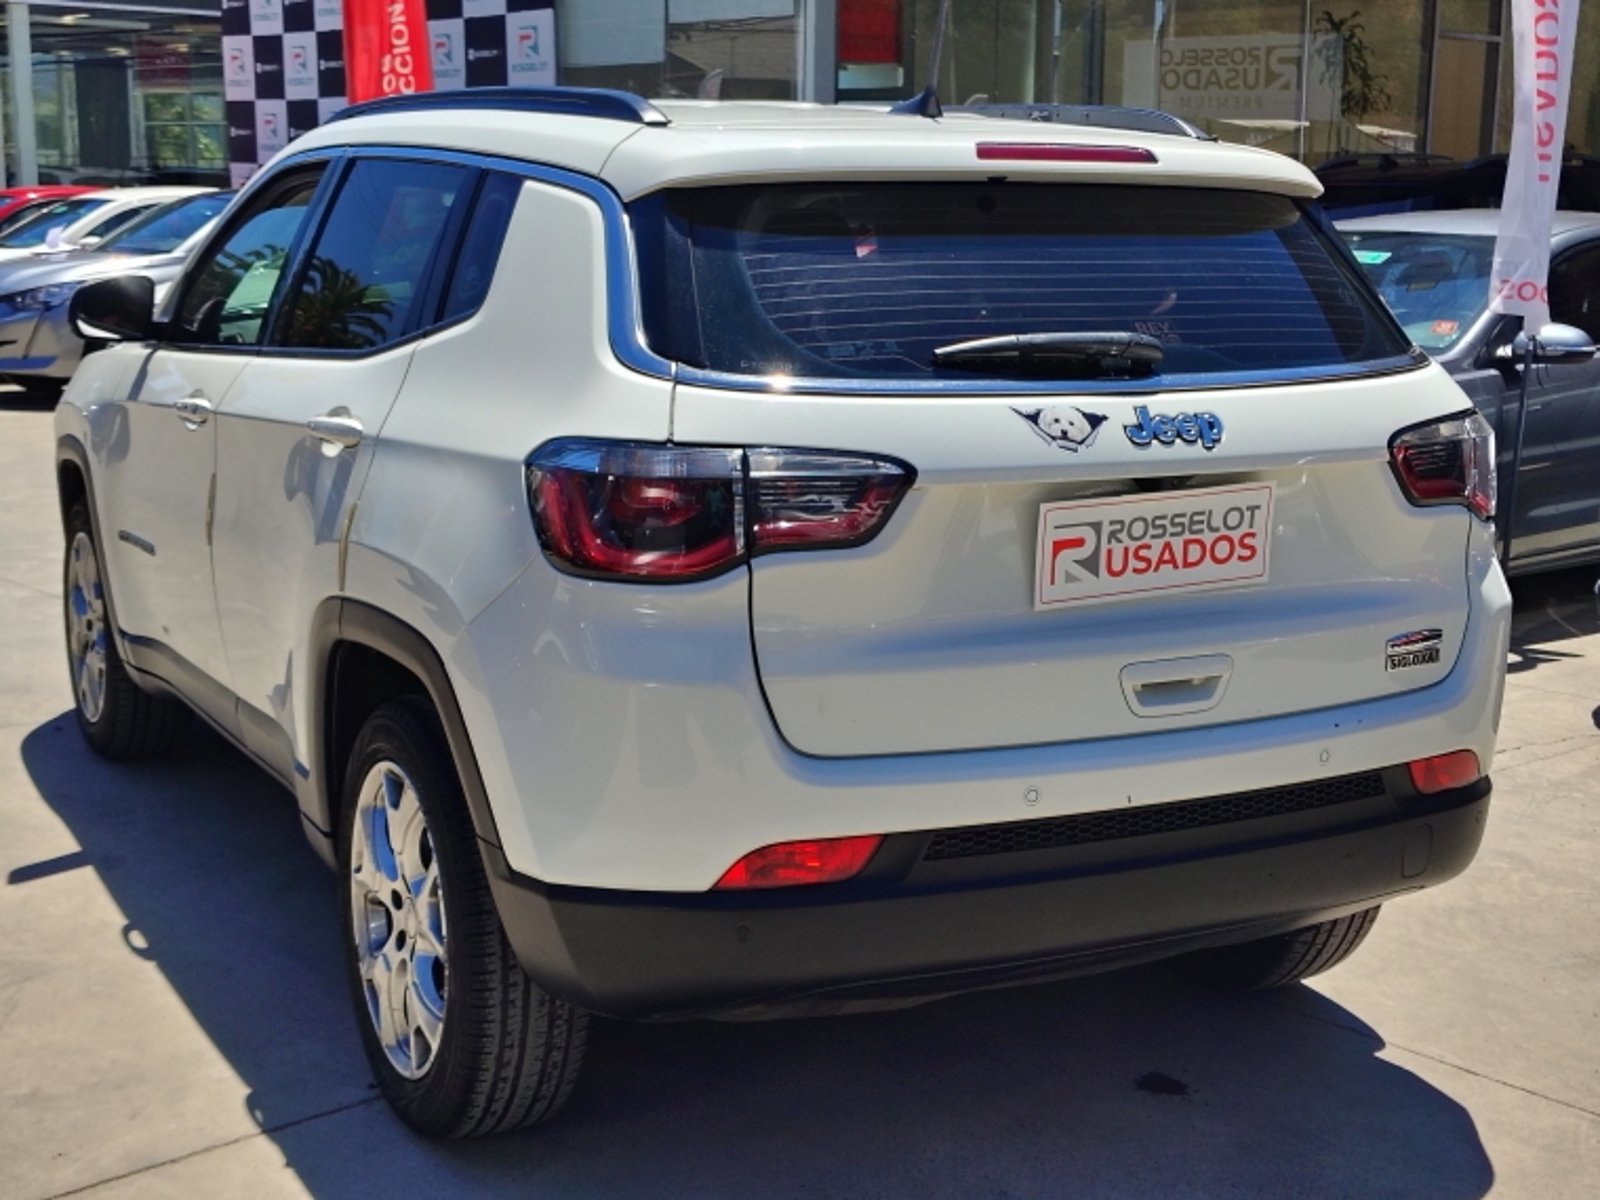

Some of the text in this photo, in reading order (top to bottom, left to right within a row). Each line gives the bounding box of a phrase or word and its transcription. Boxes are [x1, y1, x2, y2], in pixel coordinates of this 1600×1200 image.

[1122, 404, 1224, 450] Jeep
[1106, 505, 1262, 546] ROSSELOT
[1104, 532, 1259, 578] USADOS
